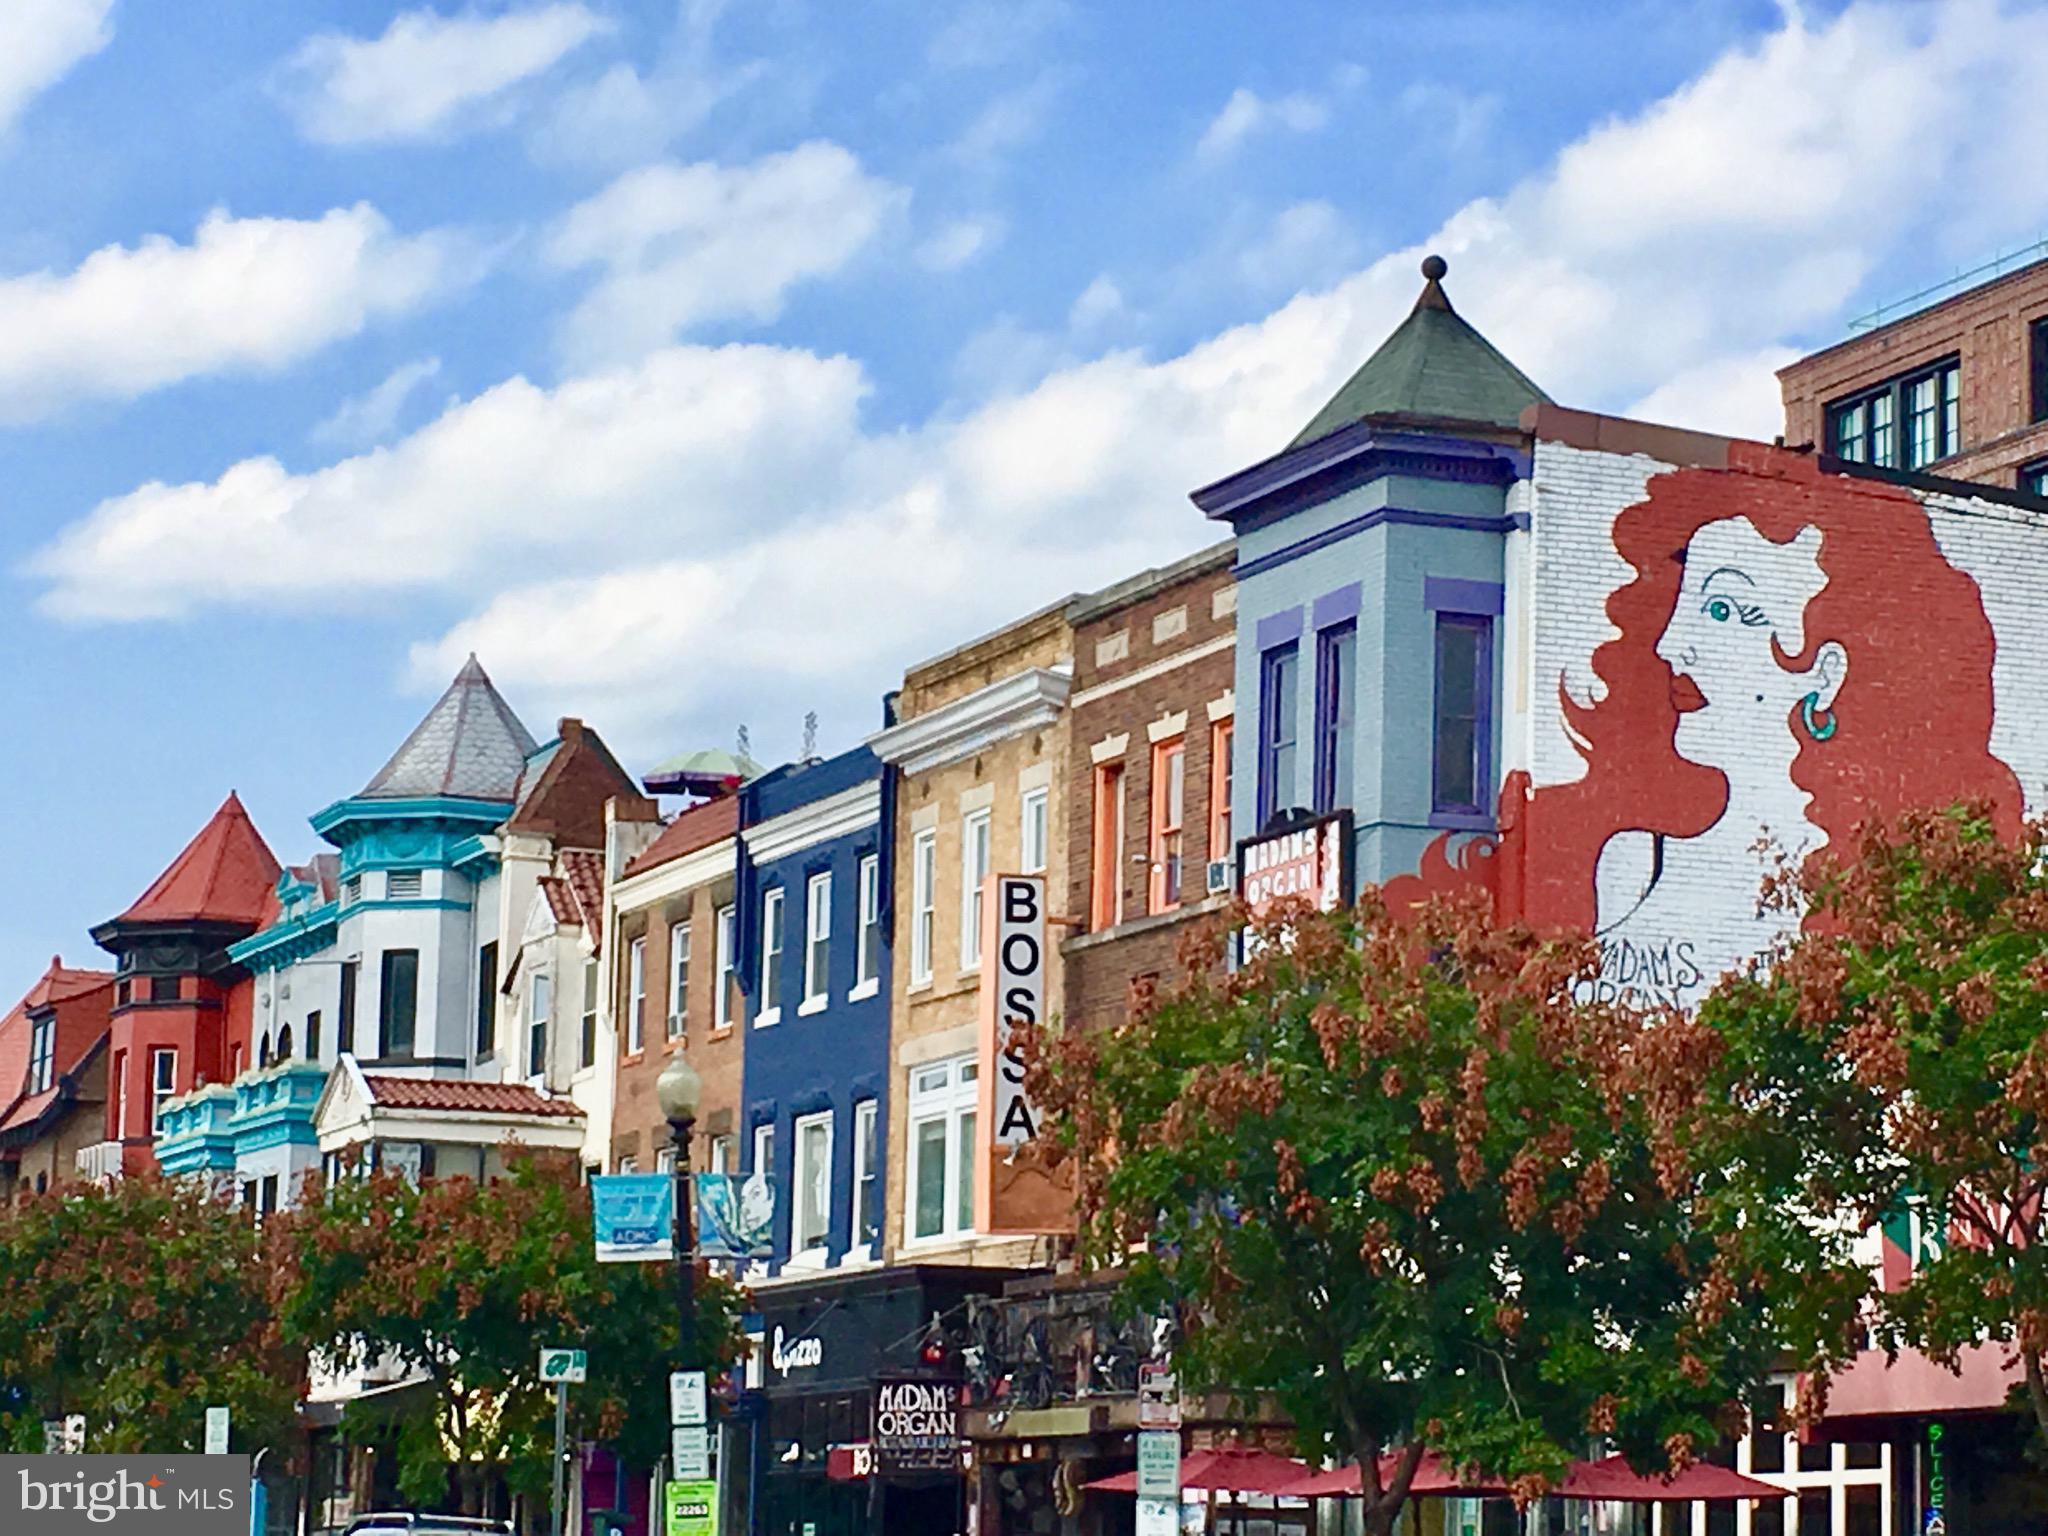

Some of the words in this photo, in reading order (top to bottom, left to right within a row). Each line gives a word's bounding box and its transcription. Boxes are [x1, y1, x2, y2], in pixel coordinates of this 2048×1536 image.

[1249, 863, 1312, 906] ORGAN
[1001, 881, 1040, 1138] BOSSA
[878, 1412, 956, 1435] ORGAN
[1928, 1424, 1944, 1509] SLICE
